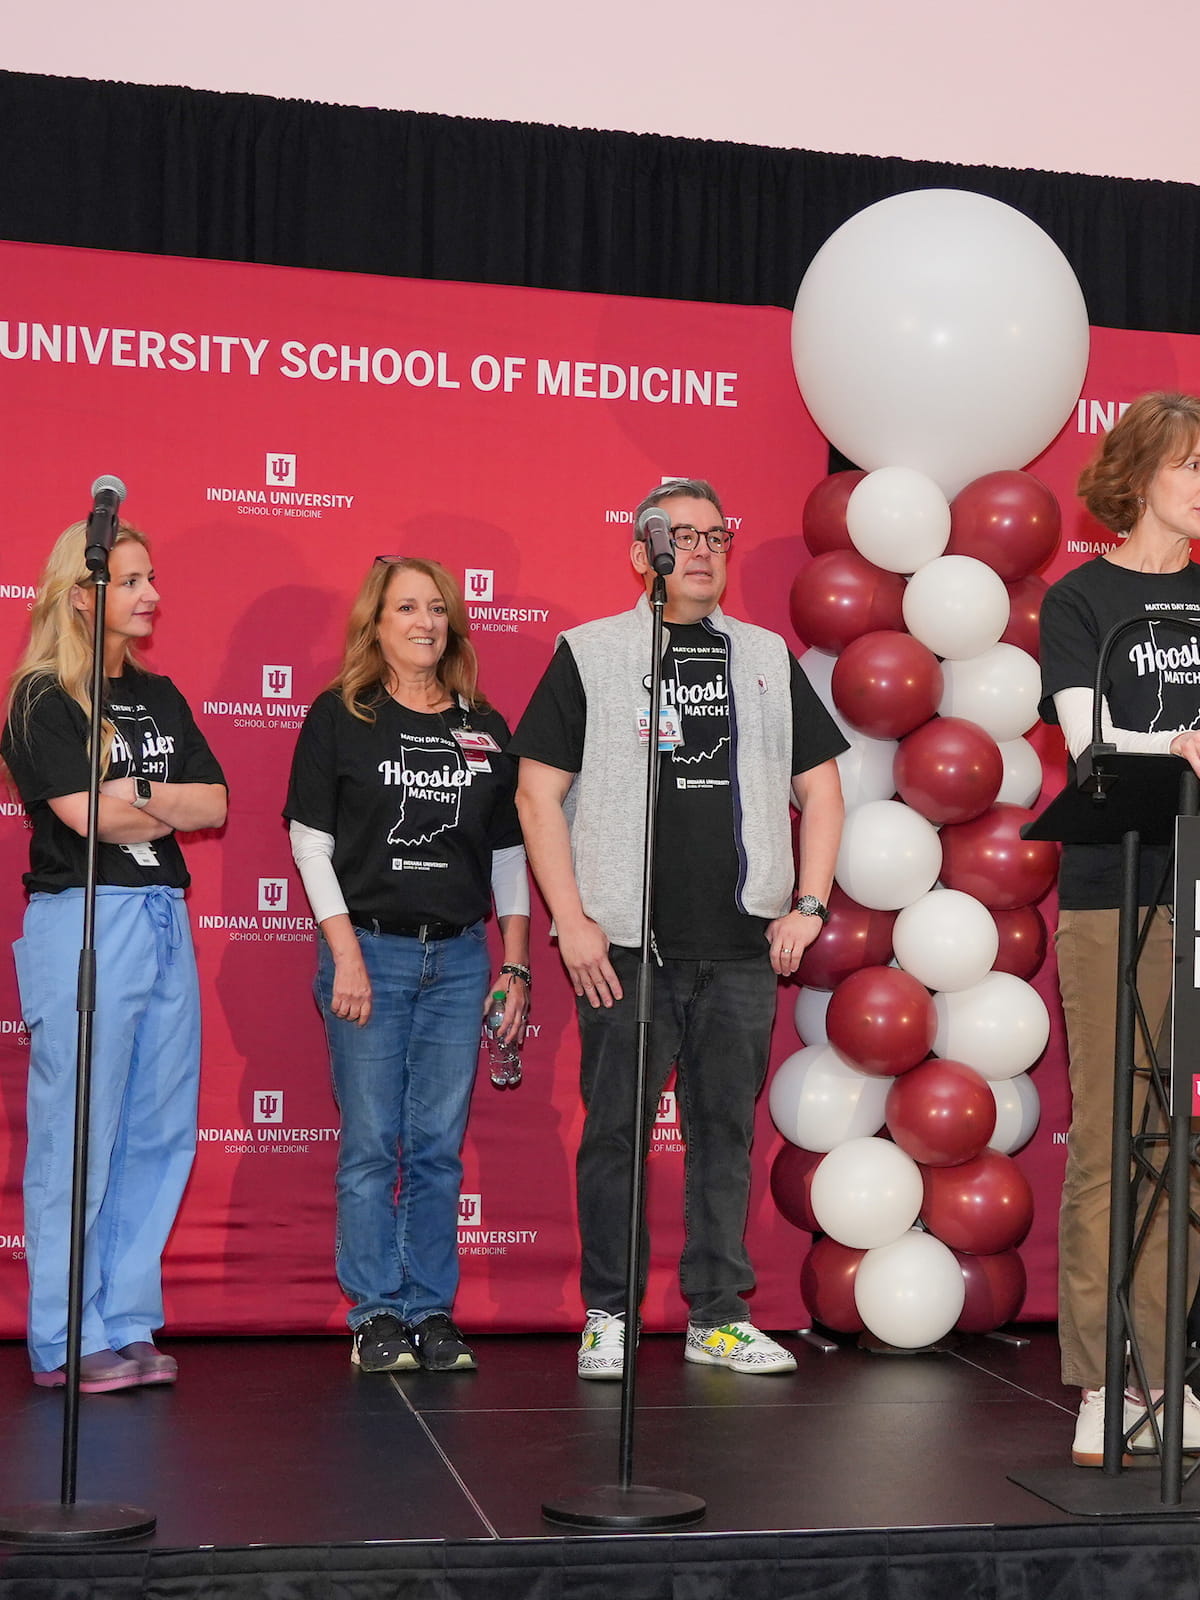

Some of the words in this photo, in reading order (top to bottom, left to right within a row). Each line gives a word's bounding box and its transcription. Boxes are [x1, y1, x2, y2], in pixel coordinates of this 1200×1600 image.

[0, 321, 269, 375] UNIVERSITY
[280, 341, 460, 389] SCHOOL
[470, 354, 523, 392] OF
[537, 358, 738, 407] MEDICINE
[206, 488, 267, 503] INDIANA
[270, 492, 354, 508] UNIVERSITY
[237, 506, 270, 516] SCHOOL
[272, 508, 283, 516] OF
[284, 509, 323, 518] MEDICINE
[605, 510, 635, 523] INDI
[1144, 603, 1171, 611] MATCH
[468, 607, 549, 622] UNIVERSITY
[470, 623, 480, 631] OF
[482, 624, 519, 633] MEDICINE
[661, 674, 727, 705] Hoosi
[203, 701, 263, 716] INDIANA
[266, 703, 311, 718] UNIVE
[685, 705, 729, 716] MATCH?
[234, 718, 267, 728] SCHOOL
[267, 719, 279, 728] OF
[400, 733, 424, 743] MATCH
[440, 738, 456, 747] 2025
[378, 760, 477, 787] Hoosier
[408, 786, 457, 804] MATCH?
[199, 915, 258, 929] INDIANA
[262, 917, 317, 930] UNIVER
[229, 932, 262, 941] SCHOOL
[264, 933, 274, 941] OF
[276, 933, 314, 942] MEDICINE
[257, 1129, 341, 1141] UNIVERSITY
[224, 1145, 257, 1153] SCHOOL
[259, 1145, 269, 1153] OF
[271, 1145, 309, 1153] MEDICINE
[456, 1231, 538, 1243] UNIVERSITY
[458, 1247, 469, 1255] OF
[470, 1247, 507, 1255] MEDICINE
